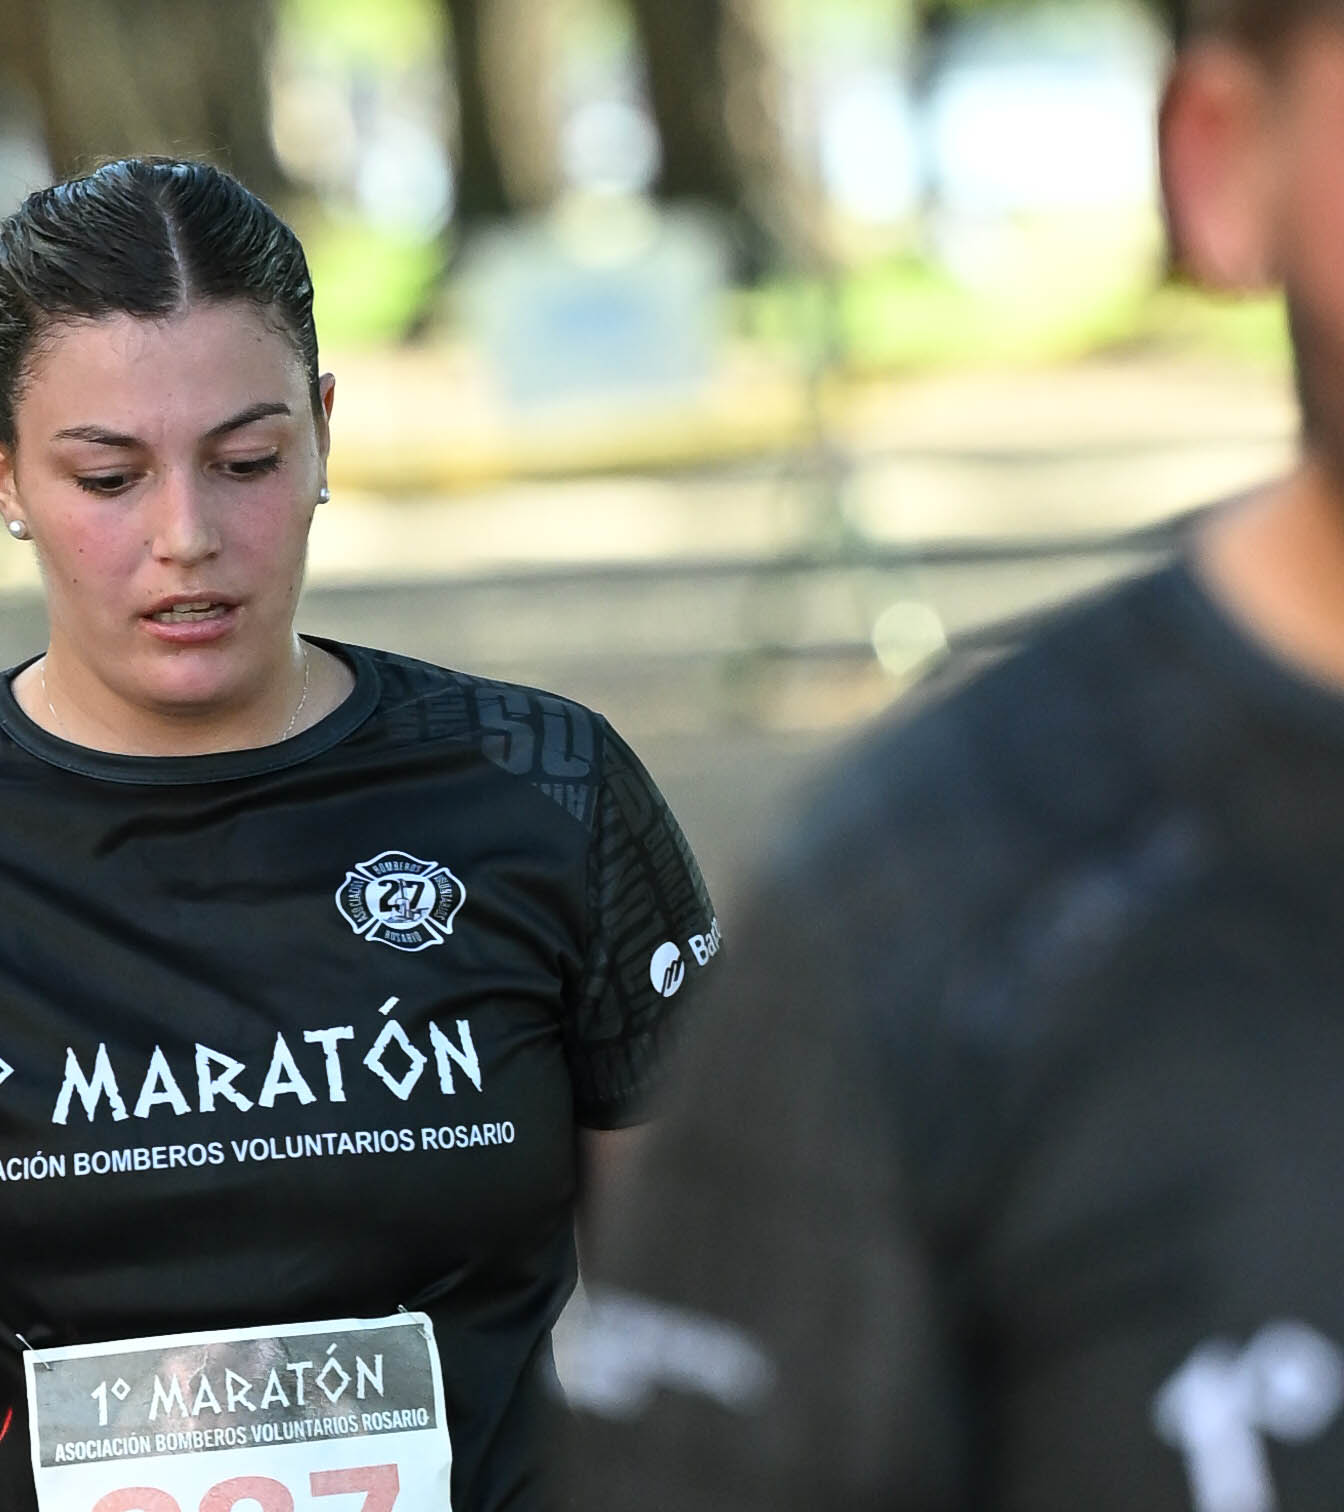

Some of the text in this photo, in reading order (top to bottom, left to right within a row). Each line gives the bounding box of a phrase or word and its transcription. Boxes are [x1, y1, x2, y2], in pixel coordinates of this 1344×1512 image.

[377, 879, 426, 913] 27
[51, 995, 483, 1125] MARATÓN
[73, 1143, 225, 1177] BOMBEROS
[231, 1129, 415, 1163] VOLUNTARIOS
[420, 1121, 515, 1150] ROSARIO
[90, 1342, 385, 1426] 1º MARATÓN
[54, 1407, 430, 1463] ASOCIACIÓN BOMBEROS VOLUNTARIOS ROSARIO
